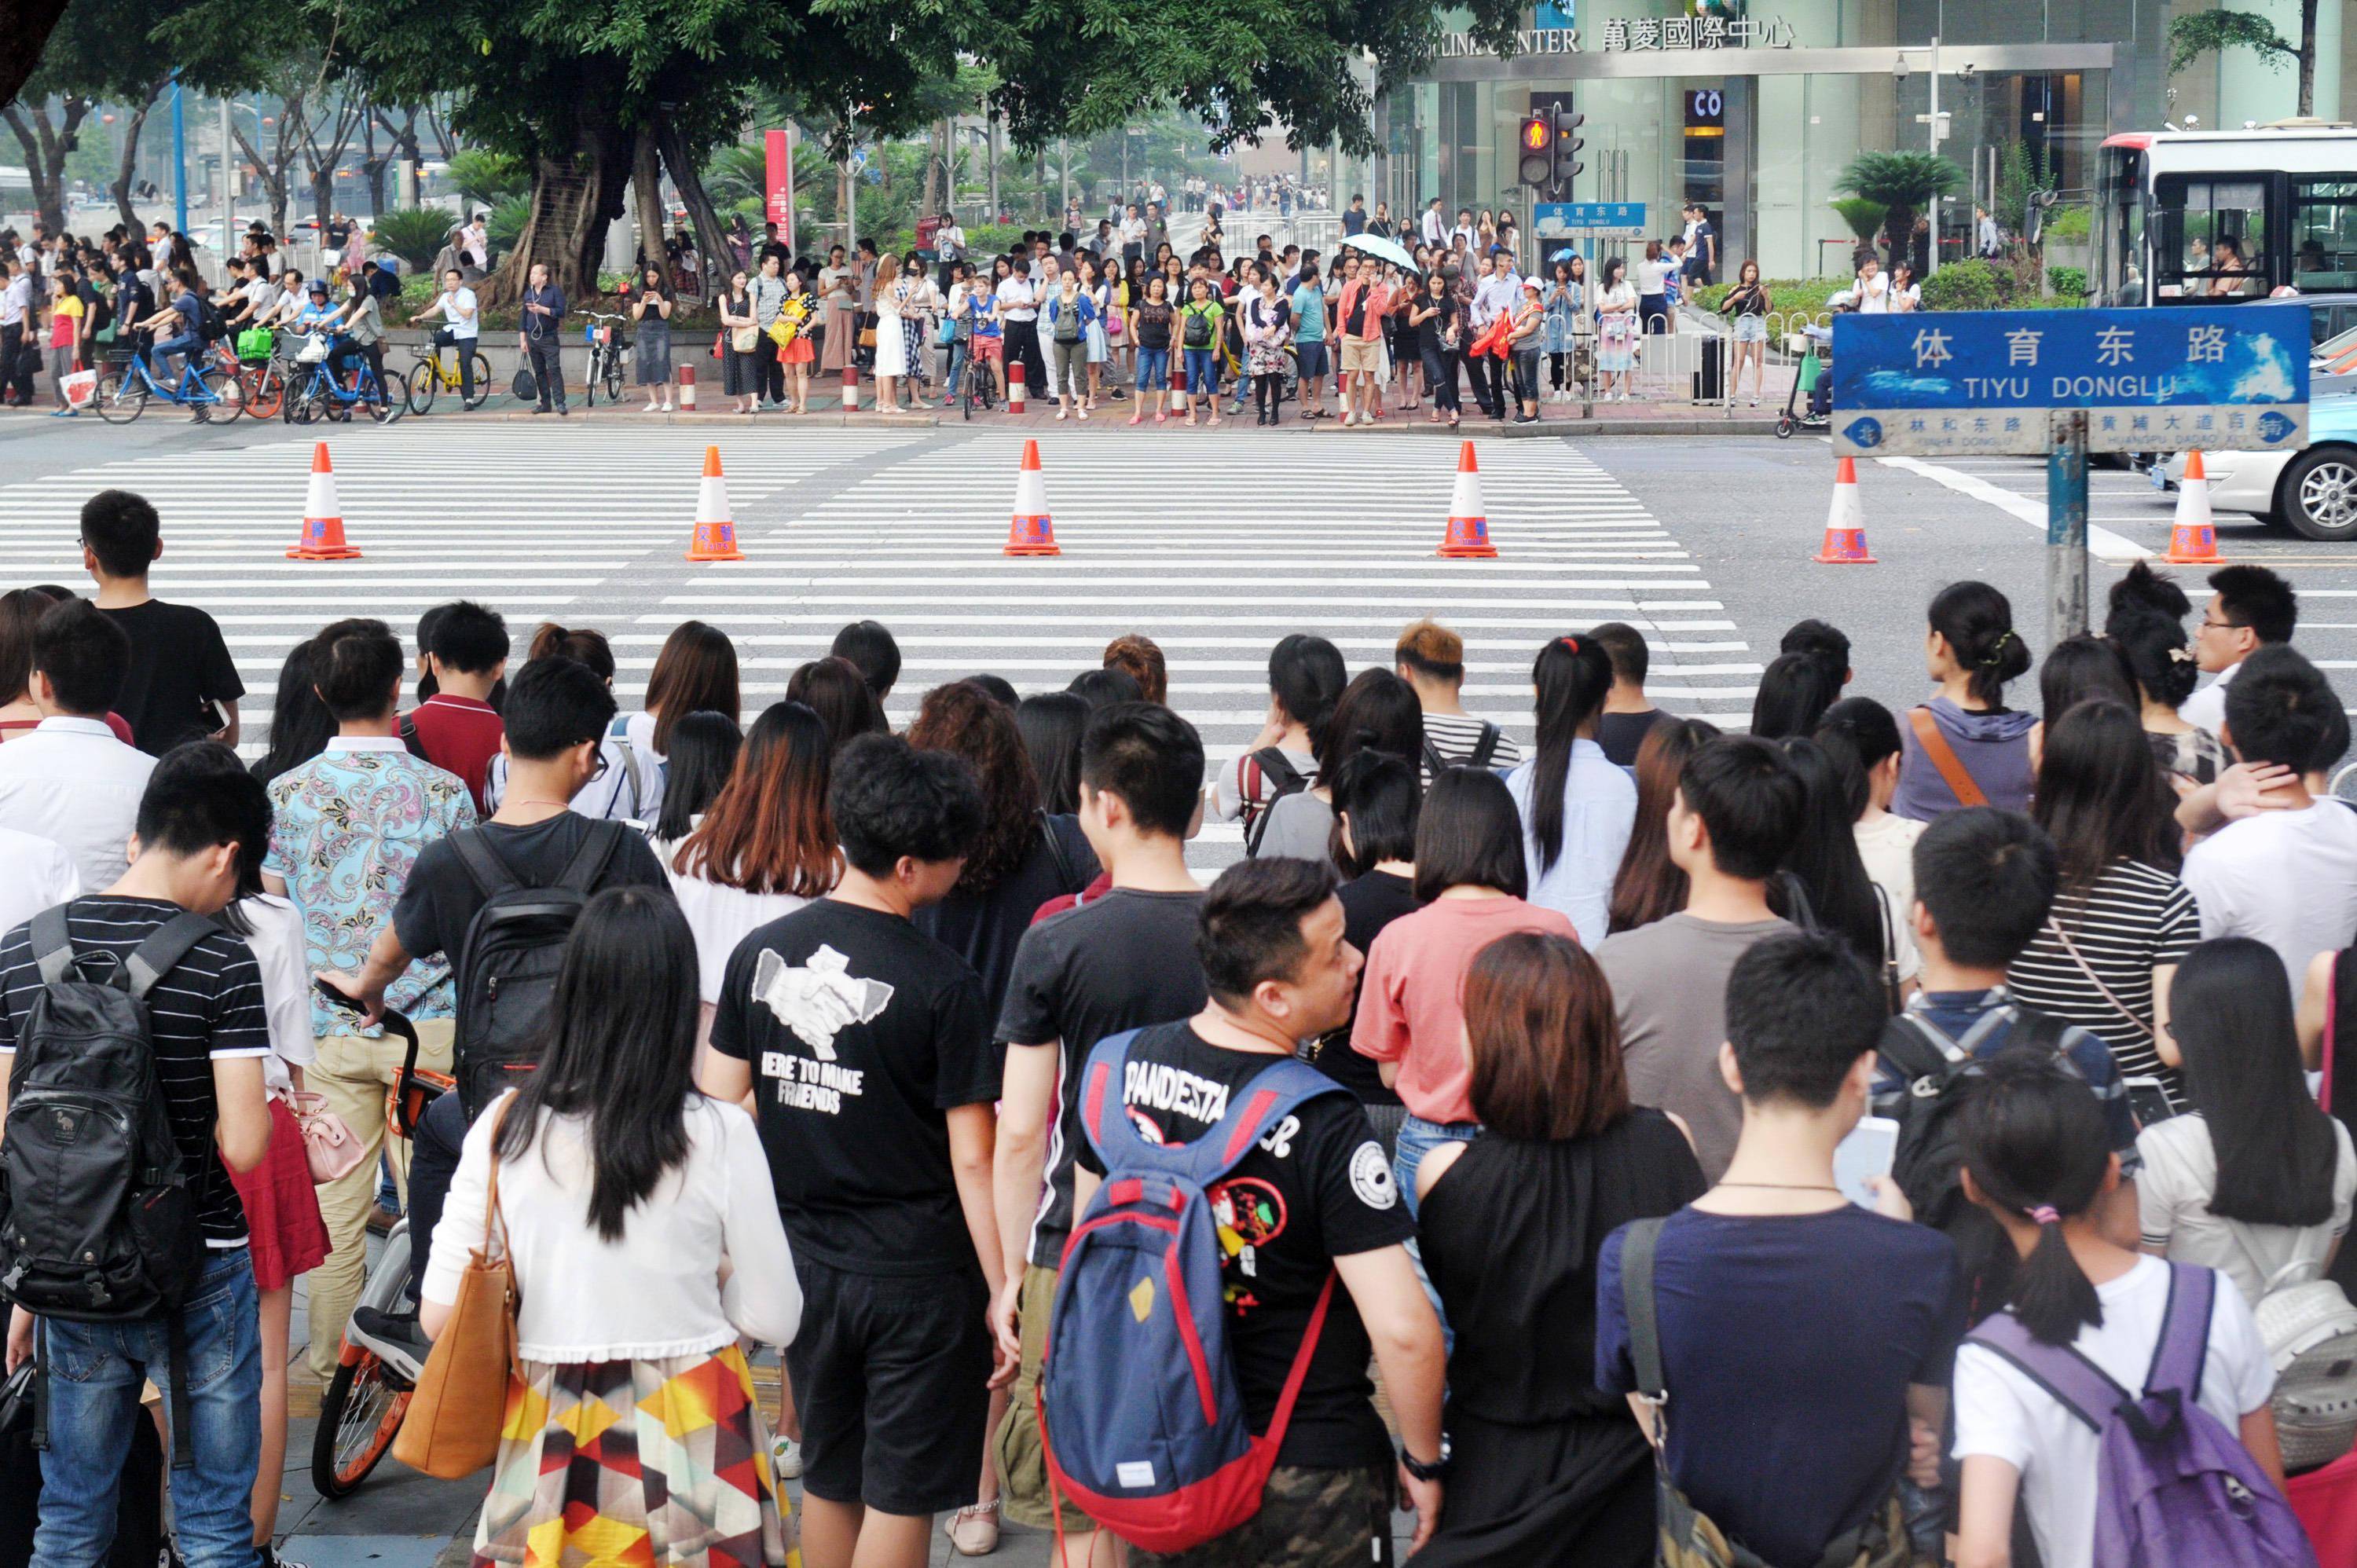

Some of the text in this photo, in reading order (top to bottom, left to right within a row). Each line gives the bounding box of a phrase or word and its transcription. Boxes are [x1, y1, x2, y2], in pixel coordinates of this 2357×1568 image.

[1486, 29, 1582, 56] CNTER
[1601, 15, 1795, 51] 萬菱國際中心
[1553, 206, 1628, 217] 体育东路
[1912, 325, 2228, 368] 体育东路
[1963, 376, 2177, 399] TIYU DONGLU
[1909, 416, 2021, 433] 林和东路
[2101, 412, 2245, 432] 黄埔大道西
[2176, 434, 2217, 444] DADAO
[798, 1057, 820, 1085] TO
[820, 1062, 864, 1096] MAKE
[778, 1079, 841, 1116] FRIENDS
